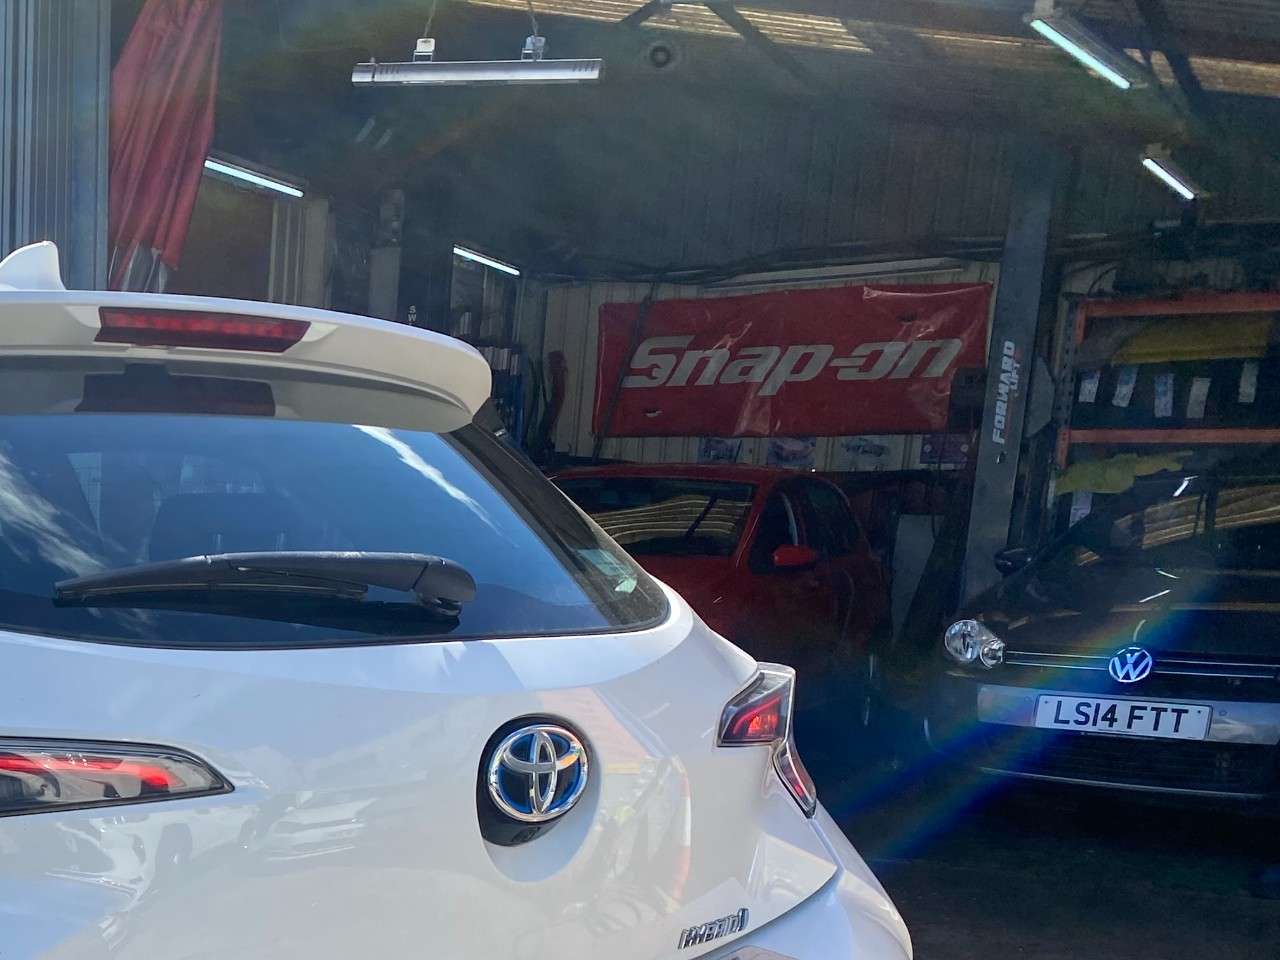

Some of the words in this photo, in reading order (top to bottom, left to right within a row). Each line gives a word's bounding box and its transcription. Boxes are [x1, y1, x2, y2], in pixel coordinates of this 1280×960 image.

[622, 335, 963, 396] Snap-on
[992, 340, 1015, 444] FORWARD
[1053, 700, 1118, 729] LS14
[1126, 705, 1189, 734] FTT
